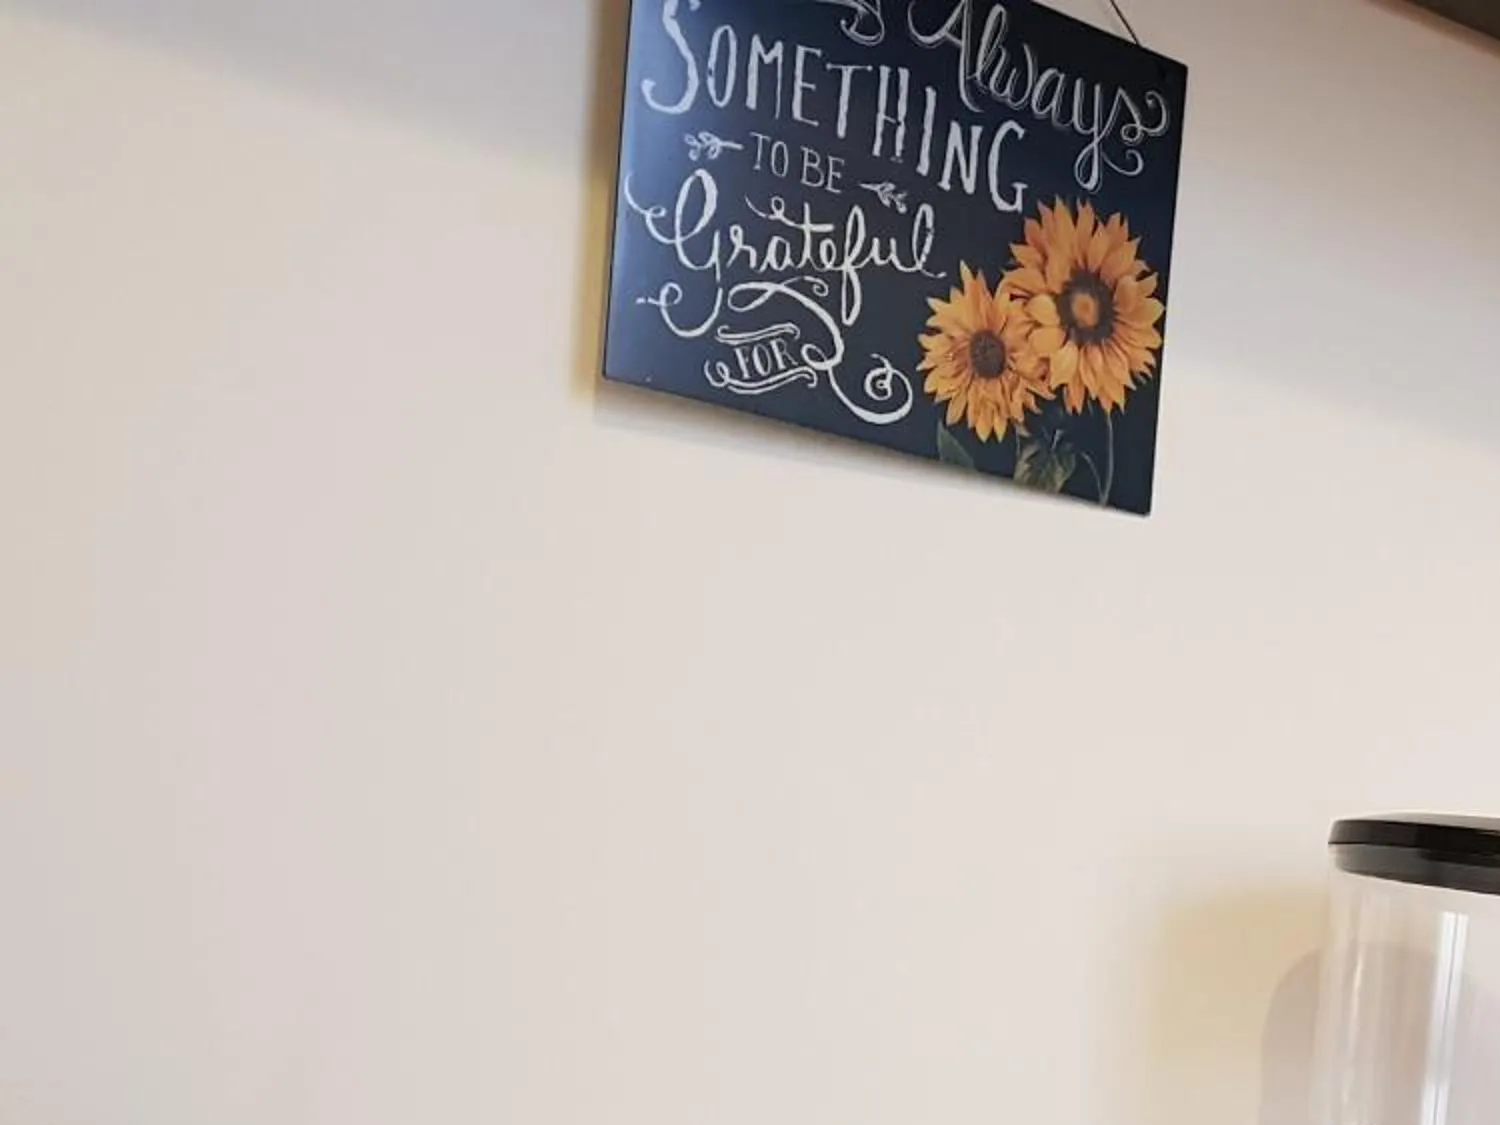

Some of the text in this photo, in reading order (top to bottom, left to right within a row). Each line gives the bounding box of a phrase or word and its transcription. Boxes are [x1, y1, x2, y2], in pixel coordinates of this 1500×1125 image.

[641, 0, 1029, 213] SOMETHING
[749, 132, 846, 194] TO BE
[908, 0, 1169, 190] Always
[624, 169, 946, 326] Grateful
[734, 336, 796, 379] FOR
